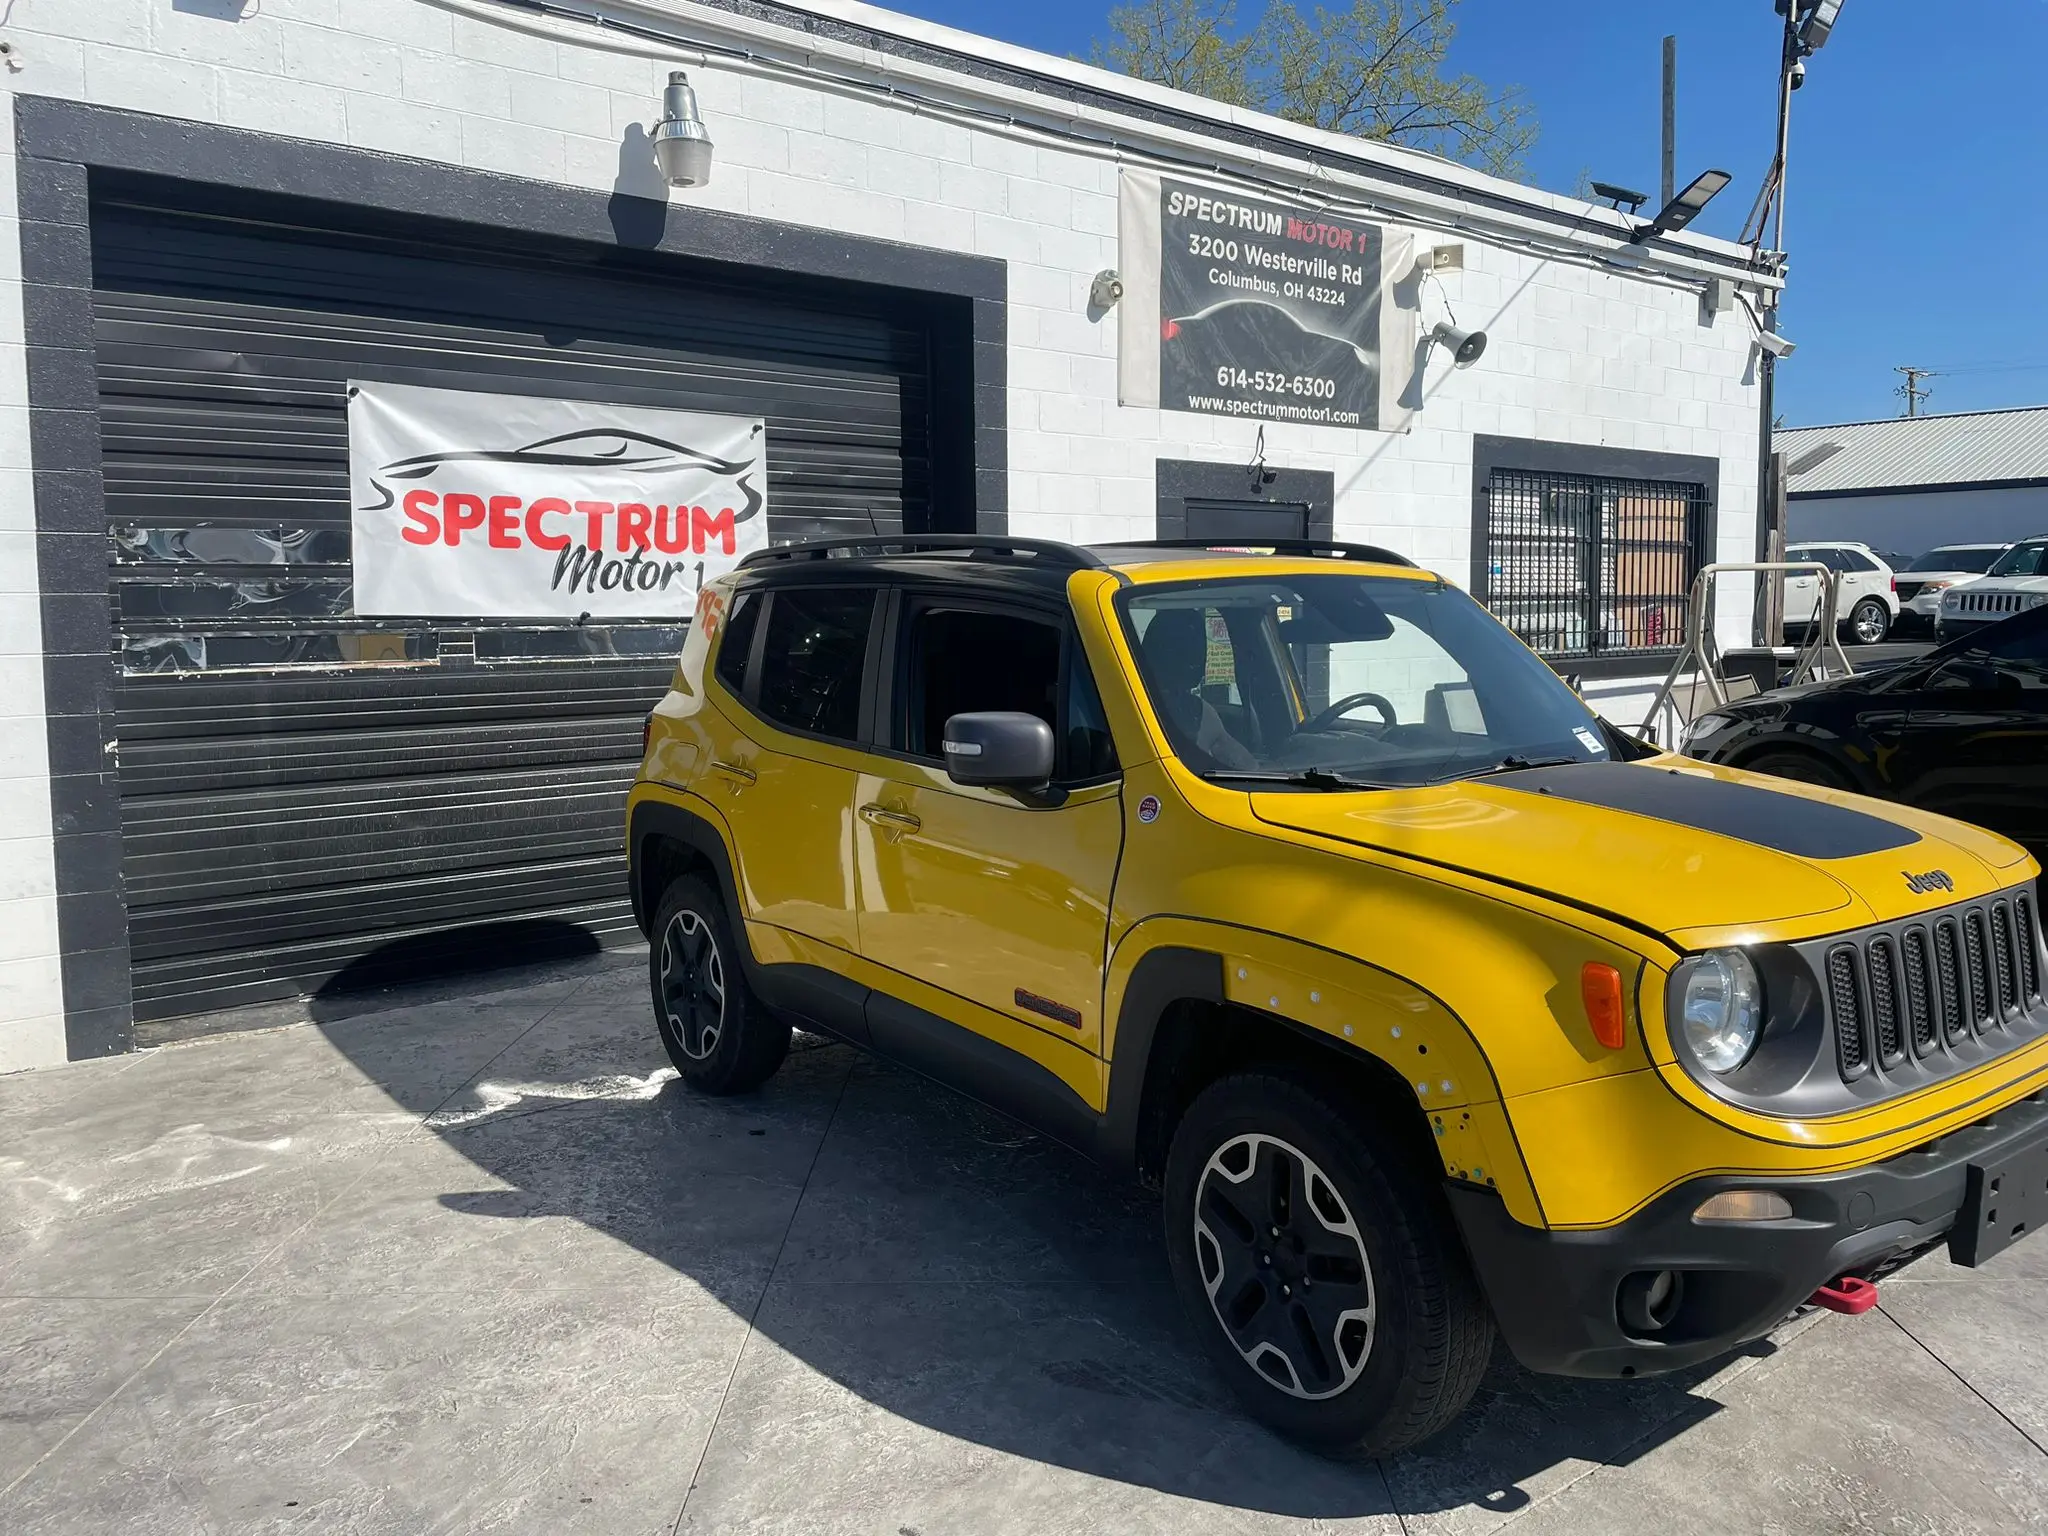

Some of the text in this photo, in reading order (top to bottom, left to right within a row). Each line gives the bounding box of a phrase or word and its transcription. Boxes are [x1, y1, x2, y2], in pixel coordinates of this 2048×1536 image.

[1168, 191, 1367, 254] SPECTRUM MOTOR 1
[1189, 233, 1362, 286] 3200 Westerville Rd
[1209, 268, 1345, 305] Columbus, OH 43224
[1217, 366, 1335, 399] 614-532-6300
[1189, 395, 1359, 424] www.spectrummotor1.com
[402, 489, 736, 556] SPECTRUM
[550, 542, 704, 595] Motor 1
[1901, 869, 1954, 894] Jeep
